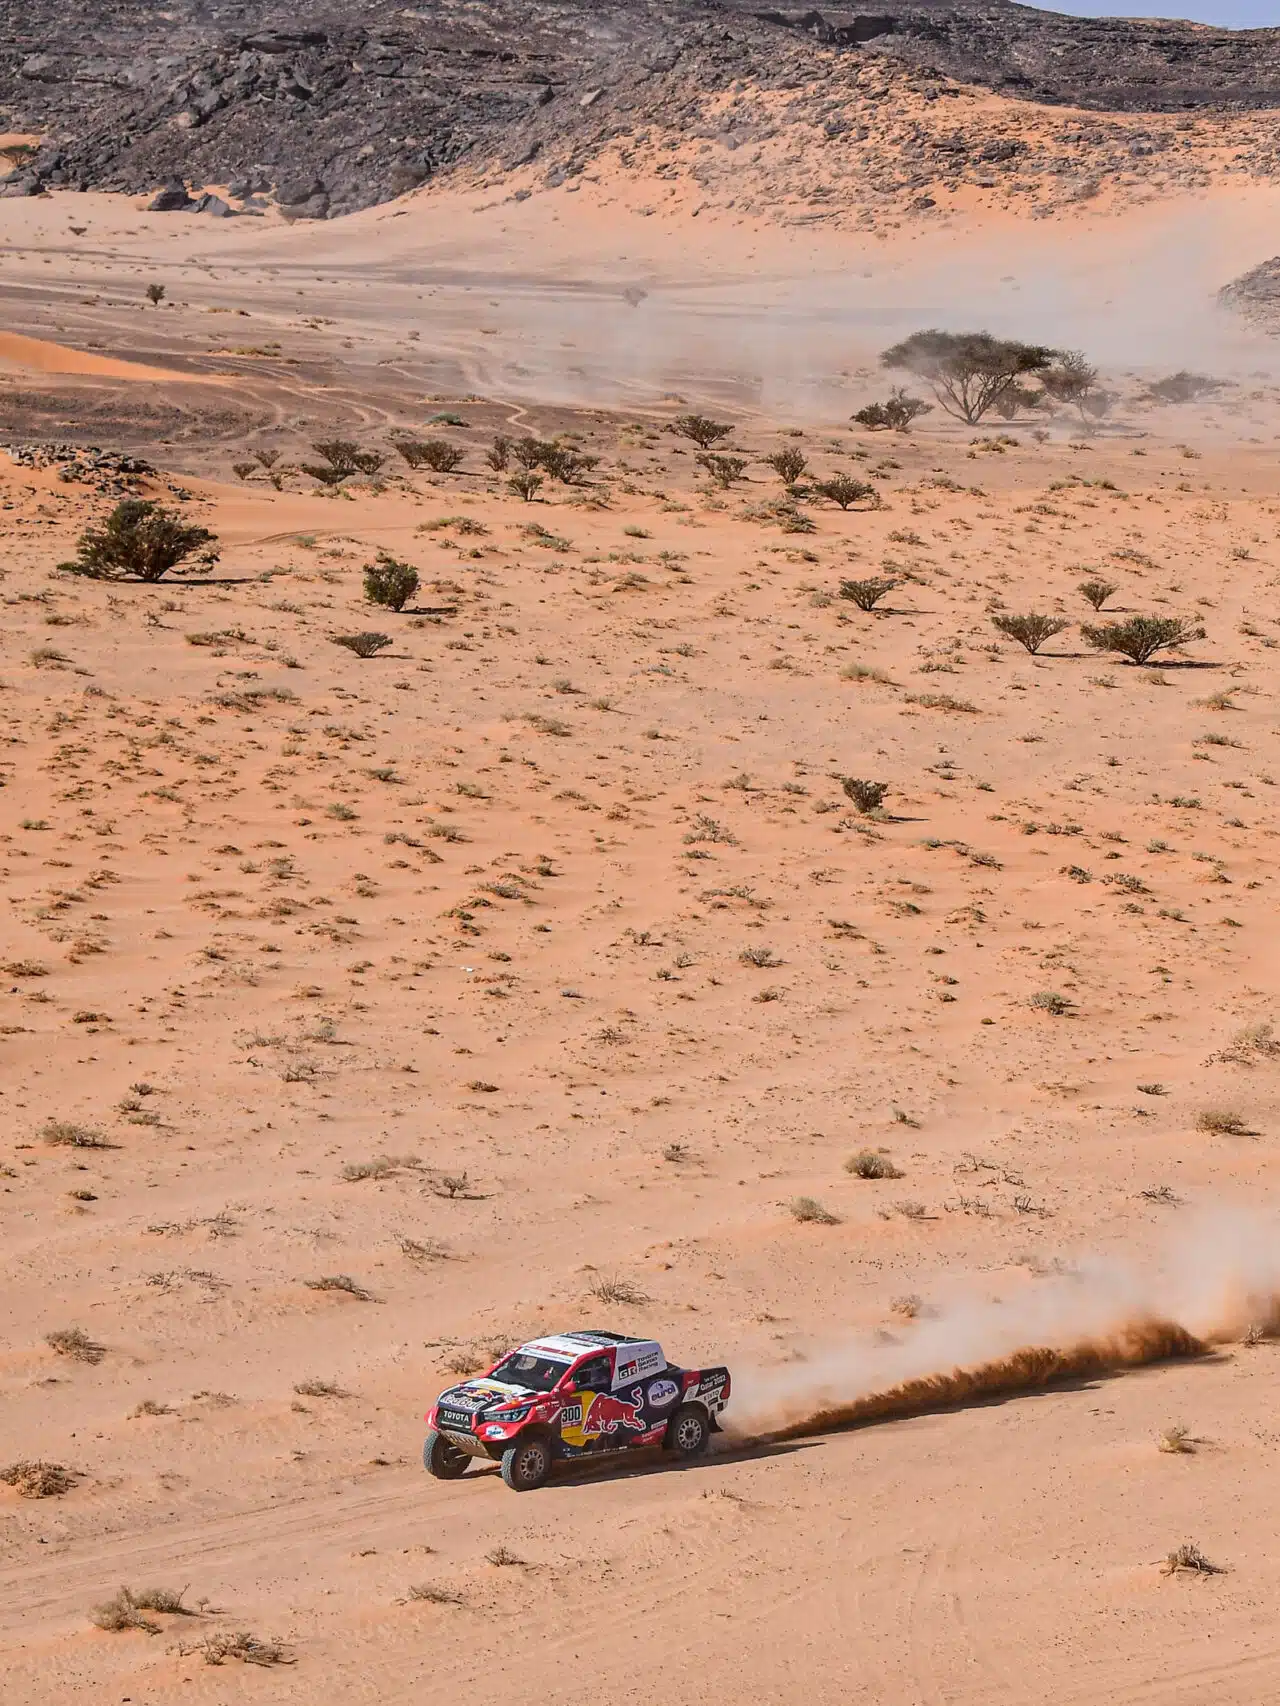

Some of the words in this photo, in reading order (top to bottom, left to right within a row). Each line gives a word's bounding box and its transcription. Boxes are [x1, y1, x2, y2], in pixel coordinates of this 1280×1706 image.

[637, 1352, 658, 1362] TOYOTA
[619, 1365, 637, 1379] GR
[651, 1384, 676, 1401] eurol
[444, 1410, 469, 1422] TOYOTA
[561, 1406, 580, 1422] 300
